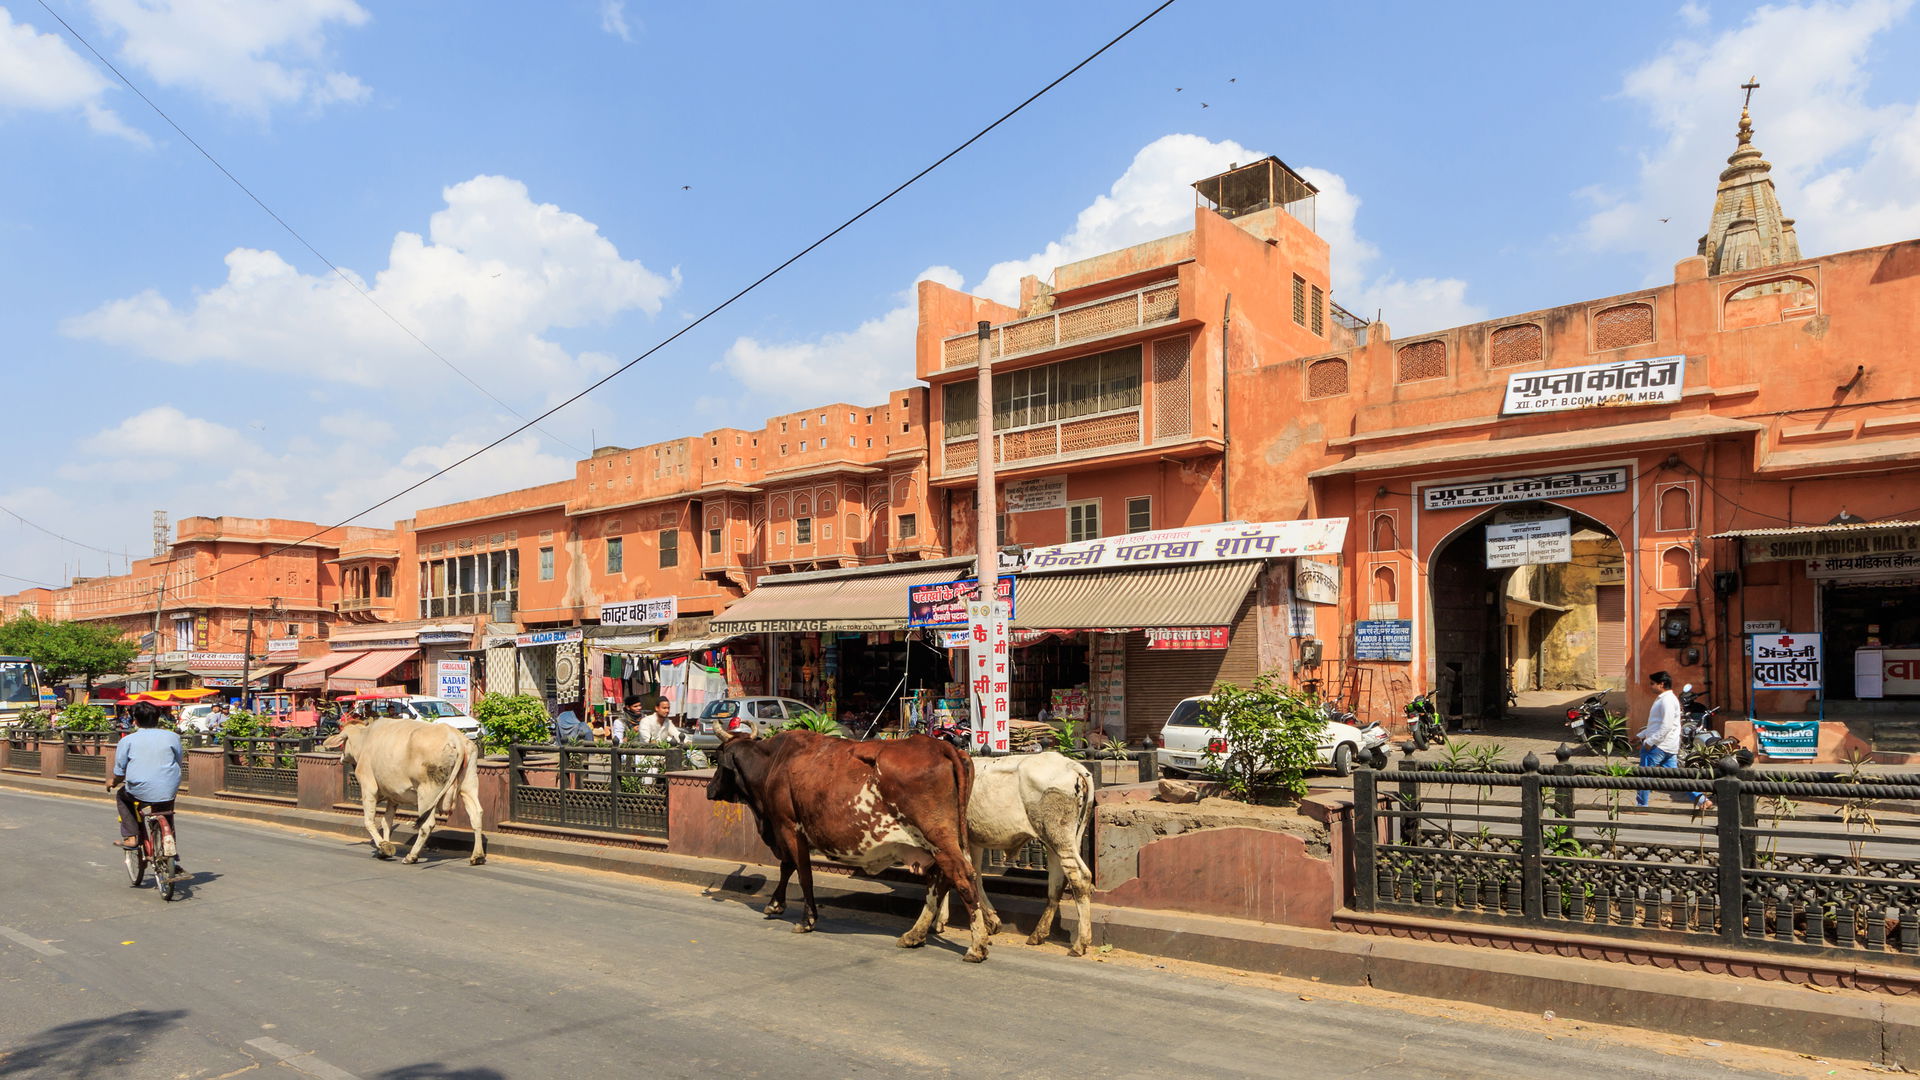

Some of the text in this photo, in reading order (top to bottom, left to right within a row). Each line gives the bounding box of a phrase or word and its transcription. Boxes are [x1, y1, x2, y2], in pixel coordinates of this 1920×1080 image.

[1513, 361, 1680, 398] गुप्ता कॉलेज
[1638, 391, 1664, 400] MBA
[1513, 472, 1619, 492] कॉलेज
[1034, 530, 1280, 568] फैन्सी पटाखा शॉप
[1770, 541, 1813, 558] SOMYA
[1816, 537, 1870, 555] MEDICAL
[1872, 534, 1905, 551] HALL
[913, 585, 943, 603] पटाखों
[943, 584, 954, 601] के
[601, 603, 647, 624] कादर बक्ष
[664, 610, 671, 618] 27
[709, 622, 757, 633] CHIRAG
[761, 620, 828, 632] HERITAGE
[531, 633, 553, 643] KADAR
[553, 631, 567, 641] BUX
[1758, 645, 1815, 658] अंग्रेजी
[442, 663, 466, 671] ORIGINAL
[442, 676, 466, 685] KADAR
[447, 686, 461, 694] BUX
[994, 681, 1007, 750] आतिशबा
